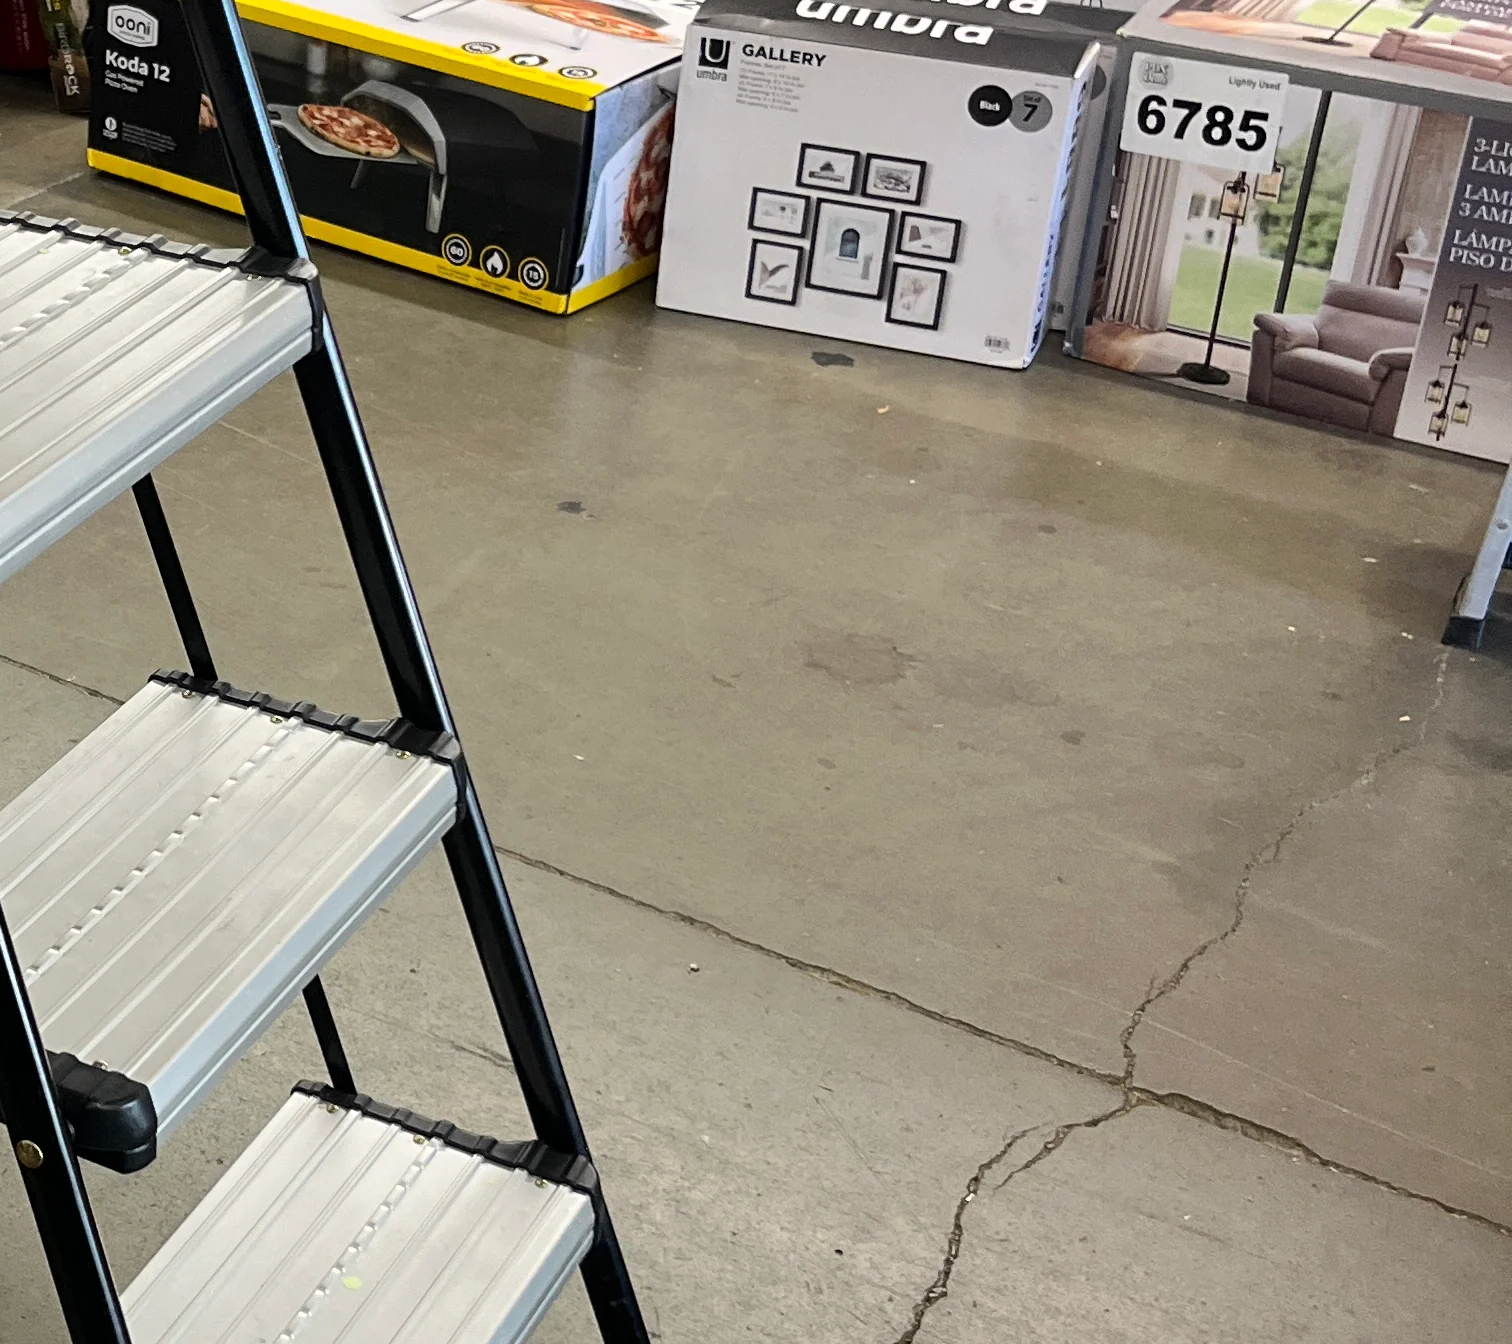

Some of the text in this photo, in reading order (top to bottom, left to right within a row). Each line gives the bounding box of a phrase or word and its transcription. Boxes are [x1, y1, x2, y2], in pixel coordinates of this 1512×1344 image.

[115, 15, 151, 36] ooni
[105, 49, 171, 83] Koda 12
[742, 43, 827, 68] GALLERY
[696, 68, 728, 83] umbra
[1228, 75, 1281, 91] Lightly Used
[1022, 103, 1038, 123] 7
[1137, 94, 1270, 153] 6785
[1458, 202, 1470, 217] 3
[1449, 247, 1495, 269] PISO
